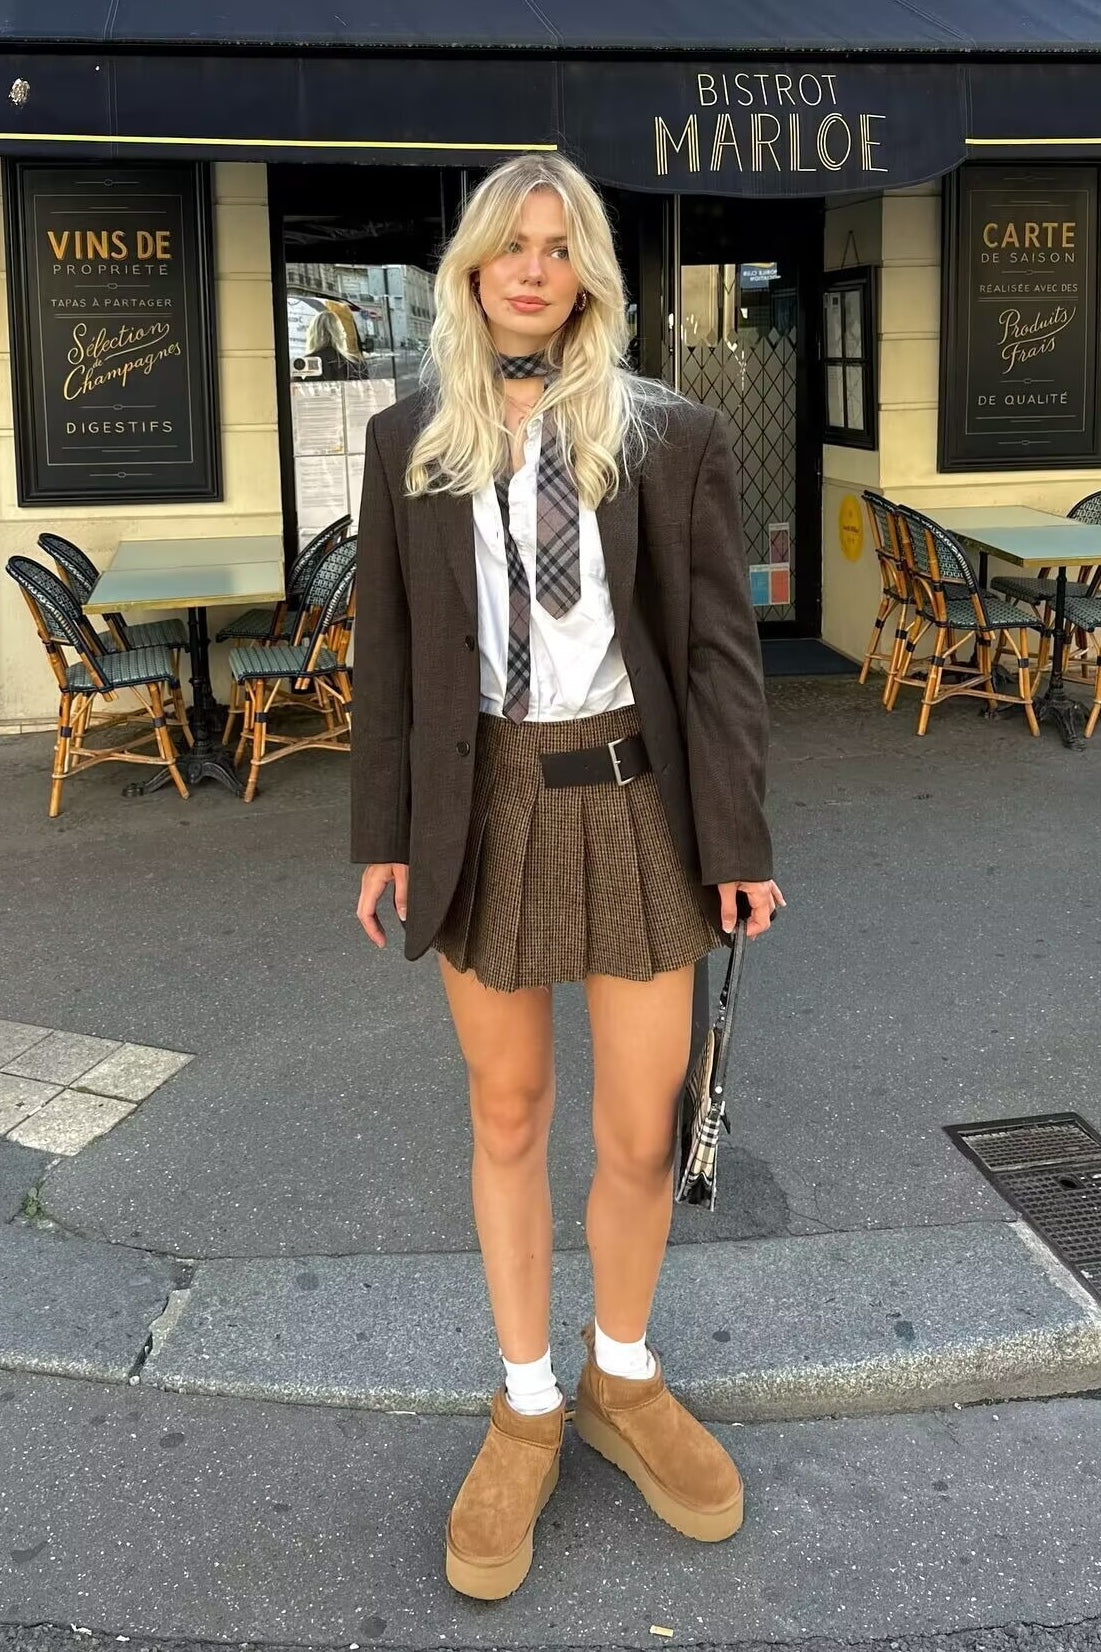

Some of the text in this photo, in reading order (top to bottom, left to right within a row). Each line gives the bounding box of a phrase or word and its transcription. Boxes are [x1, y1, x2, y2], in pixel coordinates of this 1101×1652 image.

[697, 73, 837, 107] BISTROT
[654, 112, 888, 176] MARLOE
[47, 230, 172, 261] VINS DE
[983, 222, 1076, 249] CARTE
[981, 252, 1075, 263] DE SAISON
[51, 297, 173, 308] TAPAS À PARTAGER
[979, 283, 1078, 293] RÉALISÉE AVEC DES
[997, 306, 1068, 345] Produits
[67, 322, 170, 365] Sélection
[1001, 336, 1056, 375] Frais
[63, 342, 181, 401] Champagnes
[92, 357, 103, 369] de
[978, 392, 1068, 406] DE QUALITÉ
[66, 420, 173, 434] DIGESTIFS
